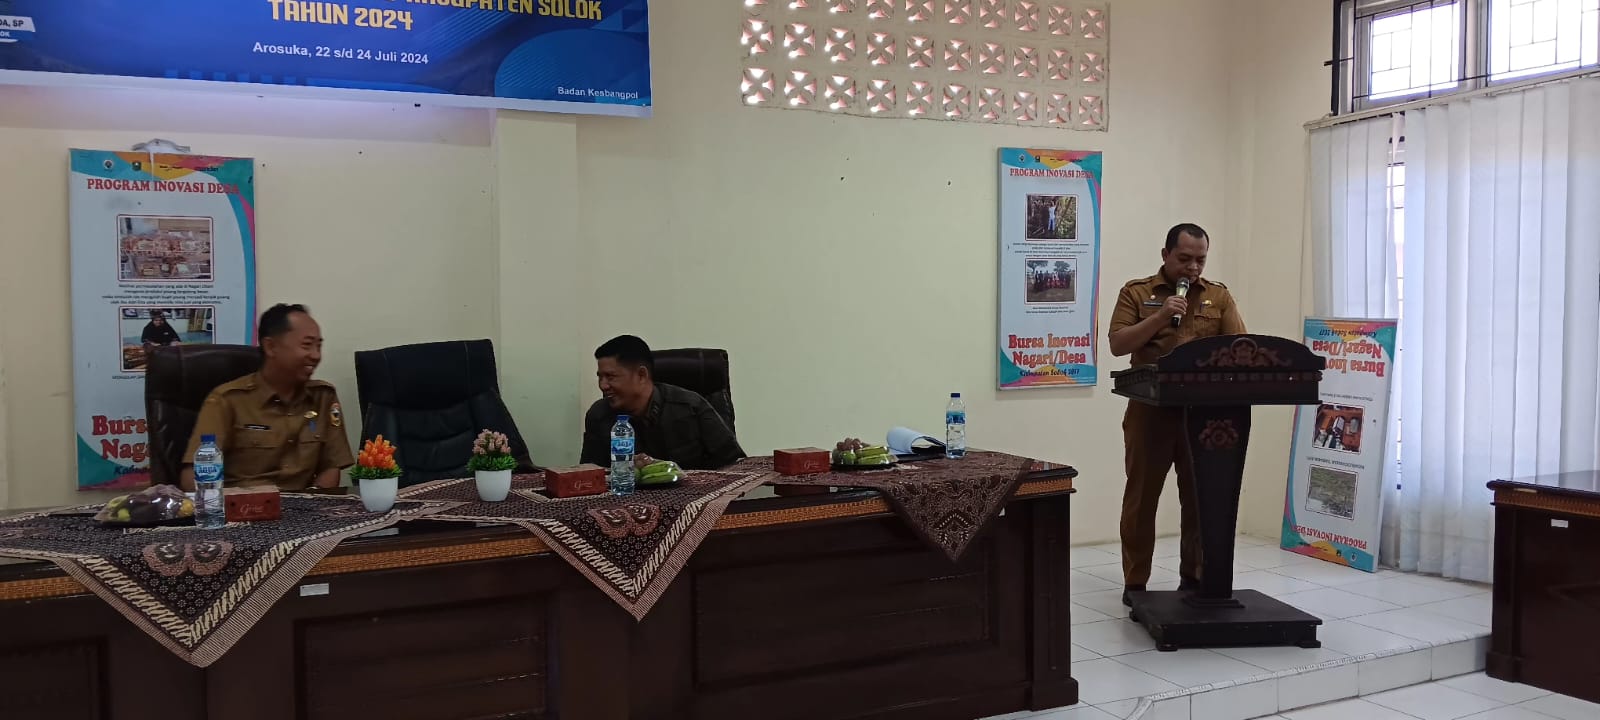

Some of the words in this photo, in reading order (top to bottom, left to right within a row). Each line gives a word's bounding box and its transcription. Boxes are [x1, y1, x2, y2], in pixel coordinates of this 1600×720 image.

[267, 0, 348, 25] TAHUN
[354, 7, 414, 31] 2024
[538, 0, 602, 20] SOLOK
[12, 19, 24, 27] SP
[252, 41, 312, 58] Arosuka,
[315, 46, 331, 57] 22
[334, 48, 353, 59] s/d
[357, 49, 372, 60] 24
[374, 51, 397, 62] Juli
[400, 52, 429, 65] 2024
[557, 86, 586, 96] Badan
[588, 88, 638, 100] Kesbangpol
[1010, 168, 1045, 177] PROGRAM
[1046, 169, 1075, 178] INOVASI
[87, 178, 151, 191] PROGRAM
[153, 180, 205, 194] INOVASI
[207, 182, 241, 195] DESA
[1008, 334, 1045, 349] Bursa
[1047, 333, 1090, 348] Inovasi
[1312, 339, 1383, 359] Nagari/Desa
[1012, 349, 1087, 369] Nagari/Desa
[1350, 359, 1386, 378] Bursa
[91, 414, 148, 436] Burs
[1333, 535, 1368, 550] PROGRAM
